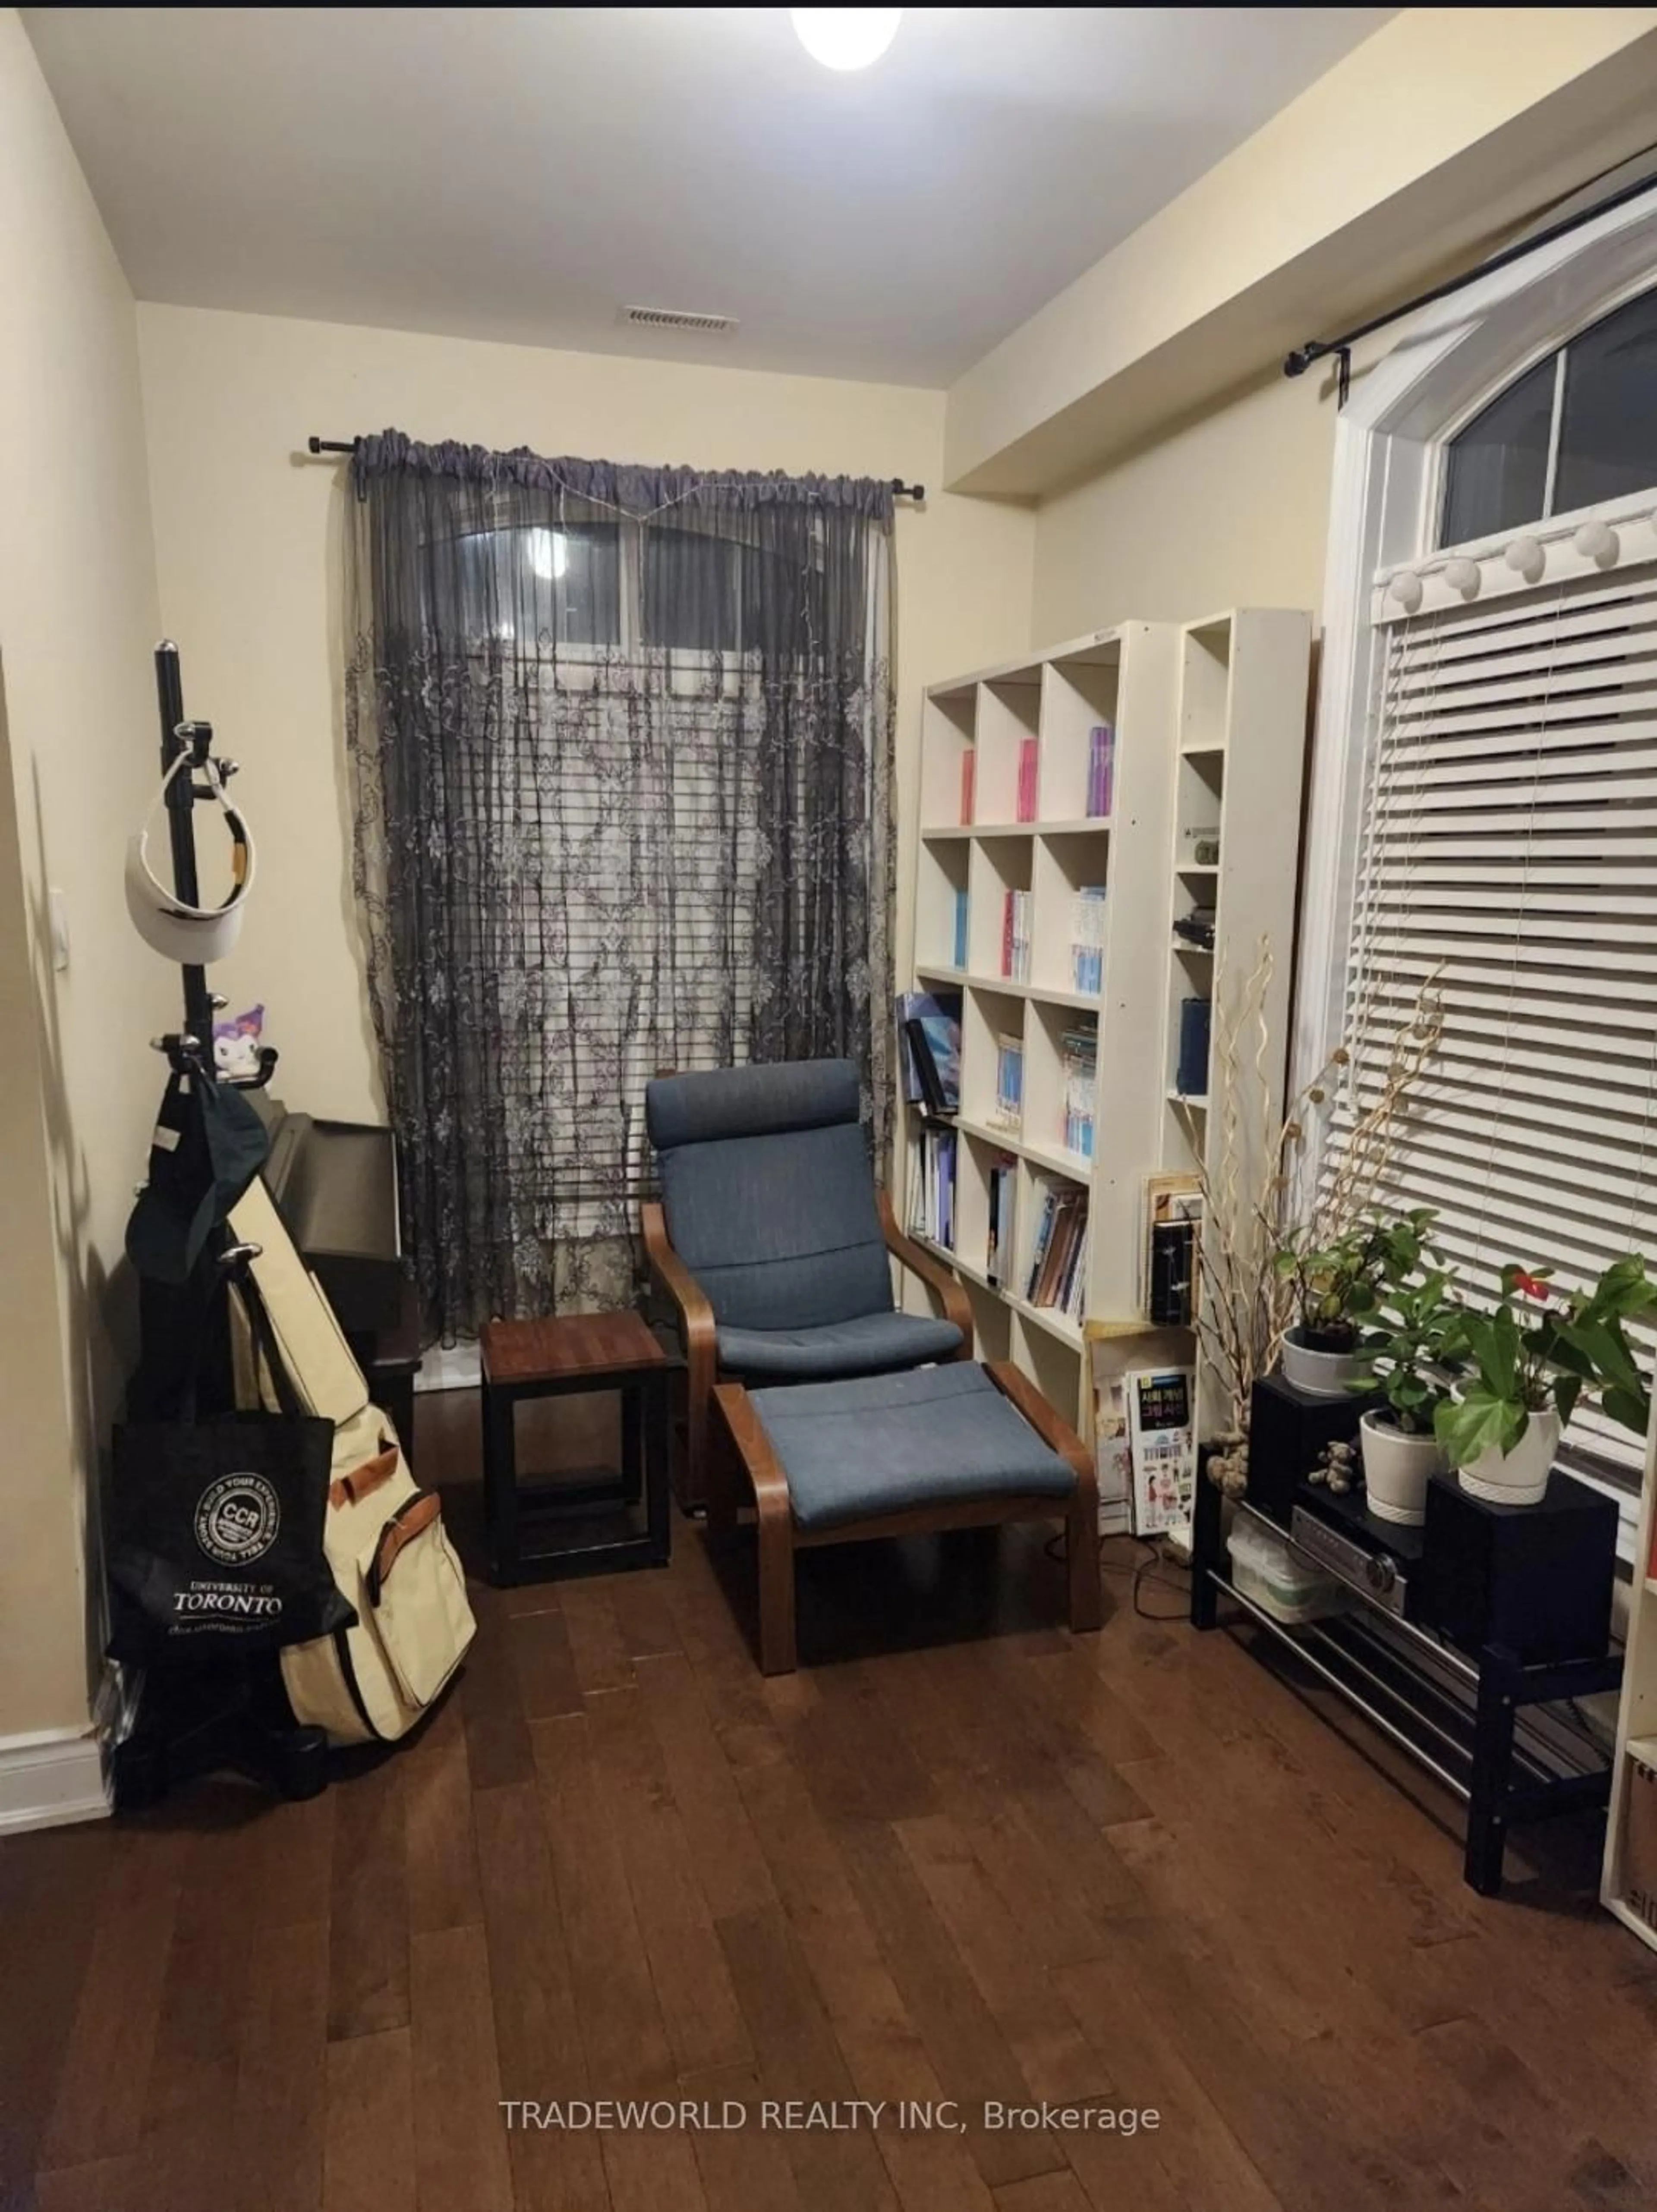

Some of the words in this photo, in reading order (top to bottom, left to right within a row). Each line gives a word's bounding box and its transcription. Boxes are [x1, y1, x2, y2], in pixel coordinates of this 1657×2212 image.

[223, 1503, 259, 1529] CCR
[190, 1581, 255, 1593] UNIVERSITY
[173, 1593, 283, 1614] TORONTO
